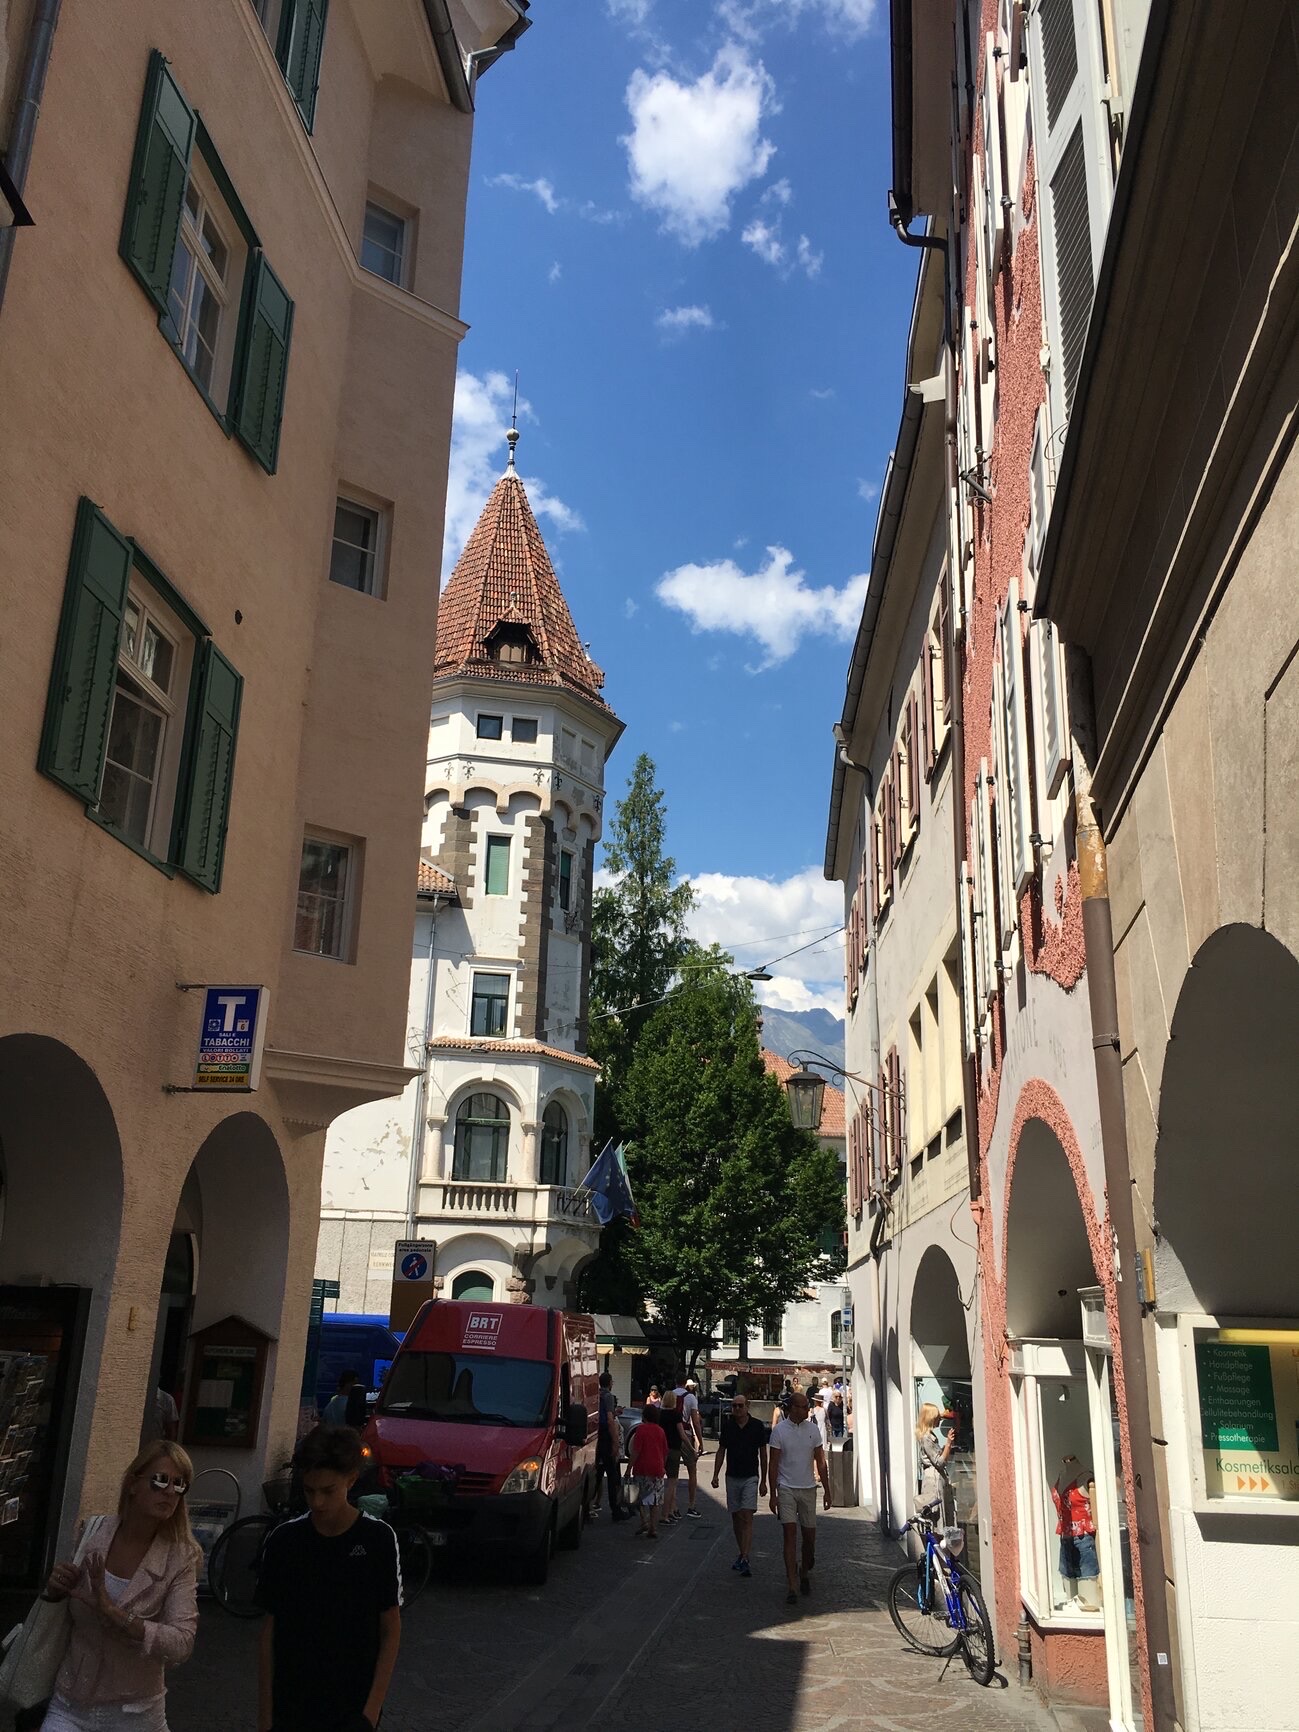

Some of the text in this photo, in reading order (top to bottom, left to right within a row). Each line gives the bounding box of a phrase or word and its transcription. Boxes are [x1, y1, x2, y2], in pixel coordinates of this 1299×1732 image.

[218, 996, 246, 1031] T
[204, 1038, 250, 1046] TABACCHI
[202, 1054, 239, 1062] LOTTO
[210, 1075, 229, 1083] SERVICE
[469, 1316, 499, 1330] BRT
[1213, 1348, 1247, 1357] Kosmetik
[1209, 1360, 1253, 1371] Handpflege
[1213, 1372, 1251, 1383] Fußpflege
[1216, 1385, 1251, 1394] Massage
[1208, 1396, 1261, 1407] Enthaarungen
[1219, 1420, 1254, 1430] Solarium
[1210, 1432, 1266, 1444] Pressotherapie
